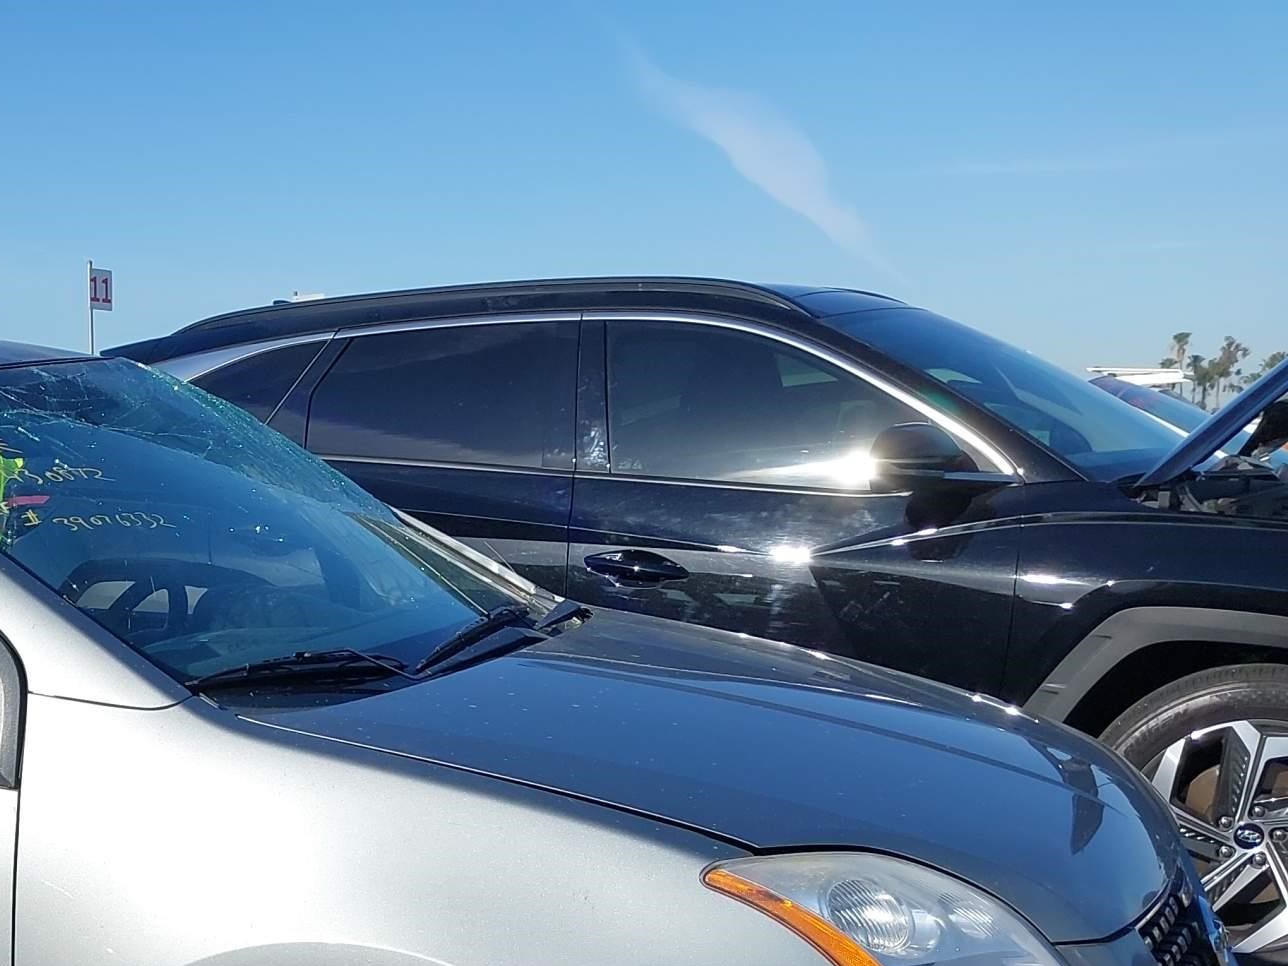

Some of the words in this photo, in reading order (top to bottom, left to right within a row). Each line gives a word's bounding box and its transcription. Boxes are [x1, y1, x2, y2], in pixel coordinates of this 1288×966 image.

[90, 276, 112, 304] 11
[21, 508, 42, 527] #
[52, 510, 177, 532] 39076332
